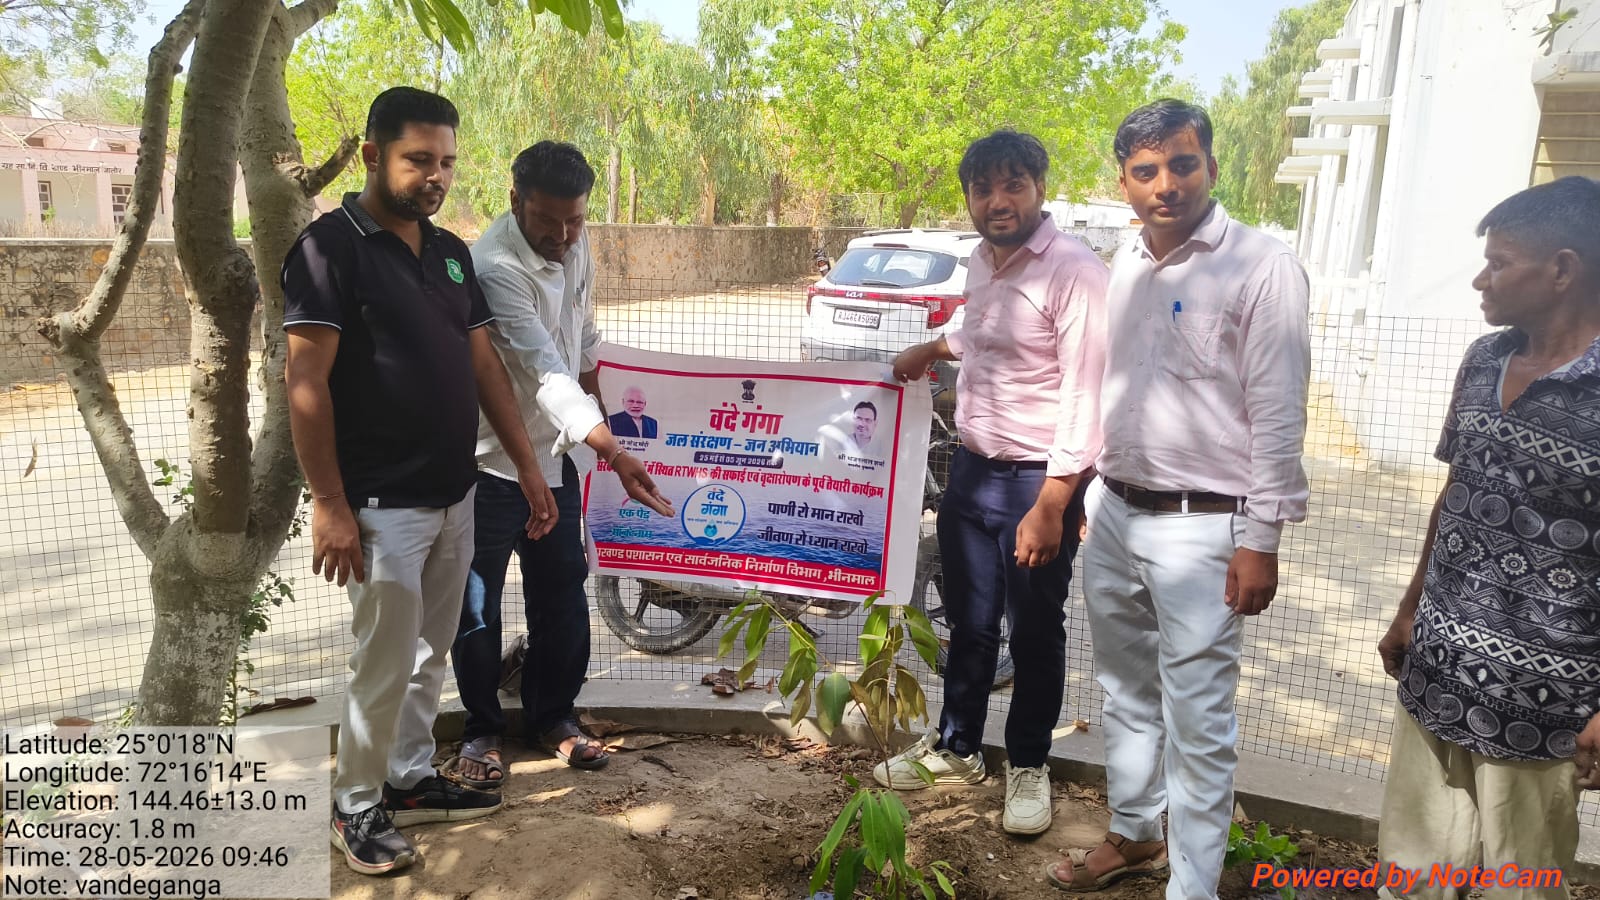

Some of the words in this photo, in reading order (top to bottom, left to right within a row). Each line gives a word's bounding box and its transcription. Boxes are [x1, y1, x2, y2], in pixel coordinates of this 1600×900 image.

[72, 163, 100, 172] भीनमाल
[710, 402, 740, 431] वंदे
[742, 405, 784, 434] गंगा
[665, 433, 689, 447] जल
[690, 431, 733, 450] संरक्षण
[745, 438, 767, 453] जन
[768, 437, 820, 456] अभियान
[709, 454, 718, 462] मई
[674, 465, 708, 479] RTWHS
[710, 466, 721, 480] की
[722, 468, 746, 484] सफाई
[747, 469, 759, 483] एवं
[760, 470, 801, 488] वृक्षारोपण
[802, 473, 811, 487] के
[812, 475, 826, 493] पूर्व
[851, 481, 885, 498] कार्यक्रम
[707, 487, 725, 502] वंदे
[701, 501, 728, 516] गंगा
[768, 500, 796, 517] पाणी
[797, 502, 809, 518] रो
[811, 507, 835, 522] मान
[836, 509, 864, 526] राखो
[757, 526, 793, 544] जीवण
[795, 530, 807, 546] रो
[809, 535, 839, 550] ध्यान
[840, 538, 869, 554] राखो
[666, 551, 683, 564] एवं
[684, 552, 743, 569] सार्वजनिक
[745, 558, 785, 574] निर्माण
[786, 562, 823, 580] विभाग
